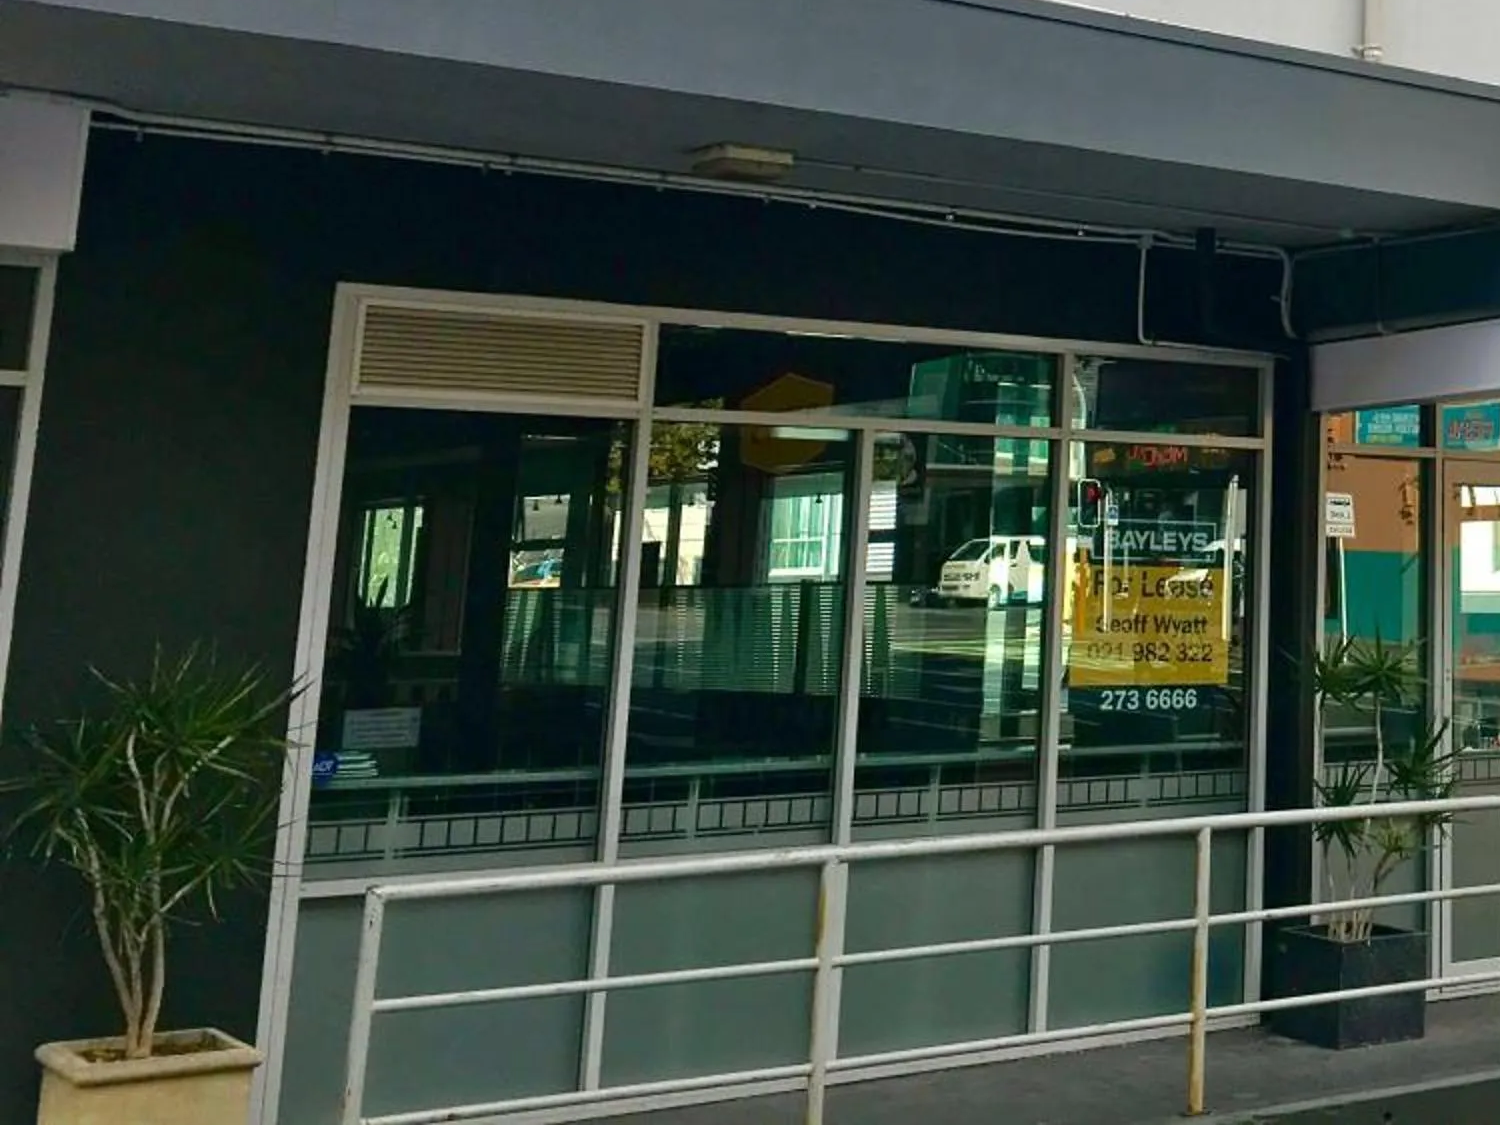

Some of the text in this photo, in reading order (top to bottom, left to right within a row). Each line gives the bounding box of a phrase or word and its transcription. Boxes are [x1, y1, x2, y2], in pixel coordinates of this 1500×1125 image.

[1109, 530, 1208, 552] BAYLEYS
[1093, 569, 1214, 599] For Lease
[1096, 613, 1208, 639] Geoff Wyatt
[1133, 642, 1171, 663] 982
[1175, 643, 1213, 663] 322
[1101, 688, 1198, 711] 273 6666
